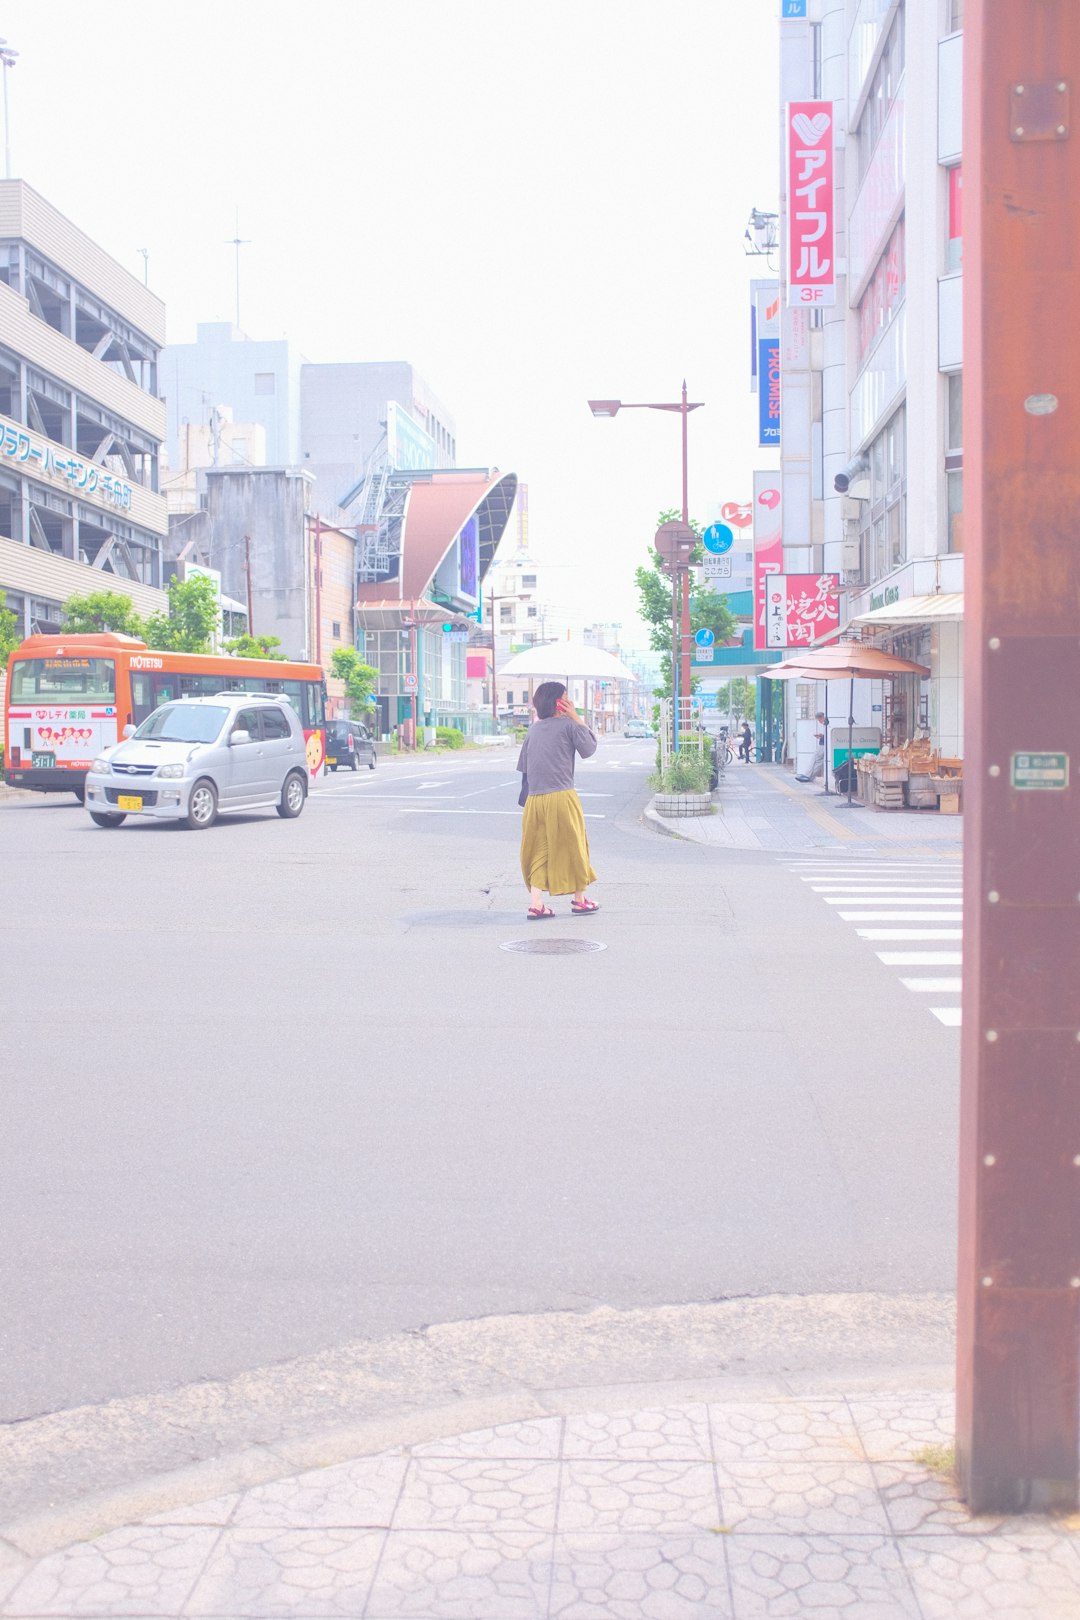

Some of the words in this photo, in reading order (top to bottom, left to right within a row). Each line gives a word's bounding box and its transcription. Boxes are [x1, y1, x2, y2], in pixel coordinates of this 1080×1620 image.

[796, 150, 830, 278] アイフル
[799, 287, 824, 302] 3F
[768, 347, 780, 419] PROMISE
[704, 567, 730, 575] ここから
[130, 655, 163, 669] IYOTETSU
